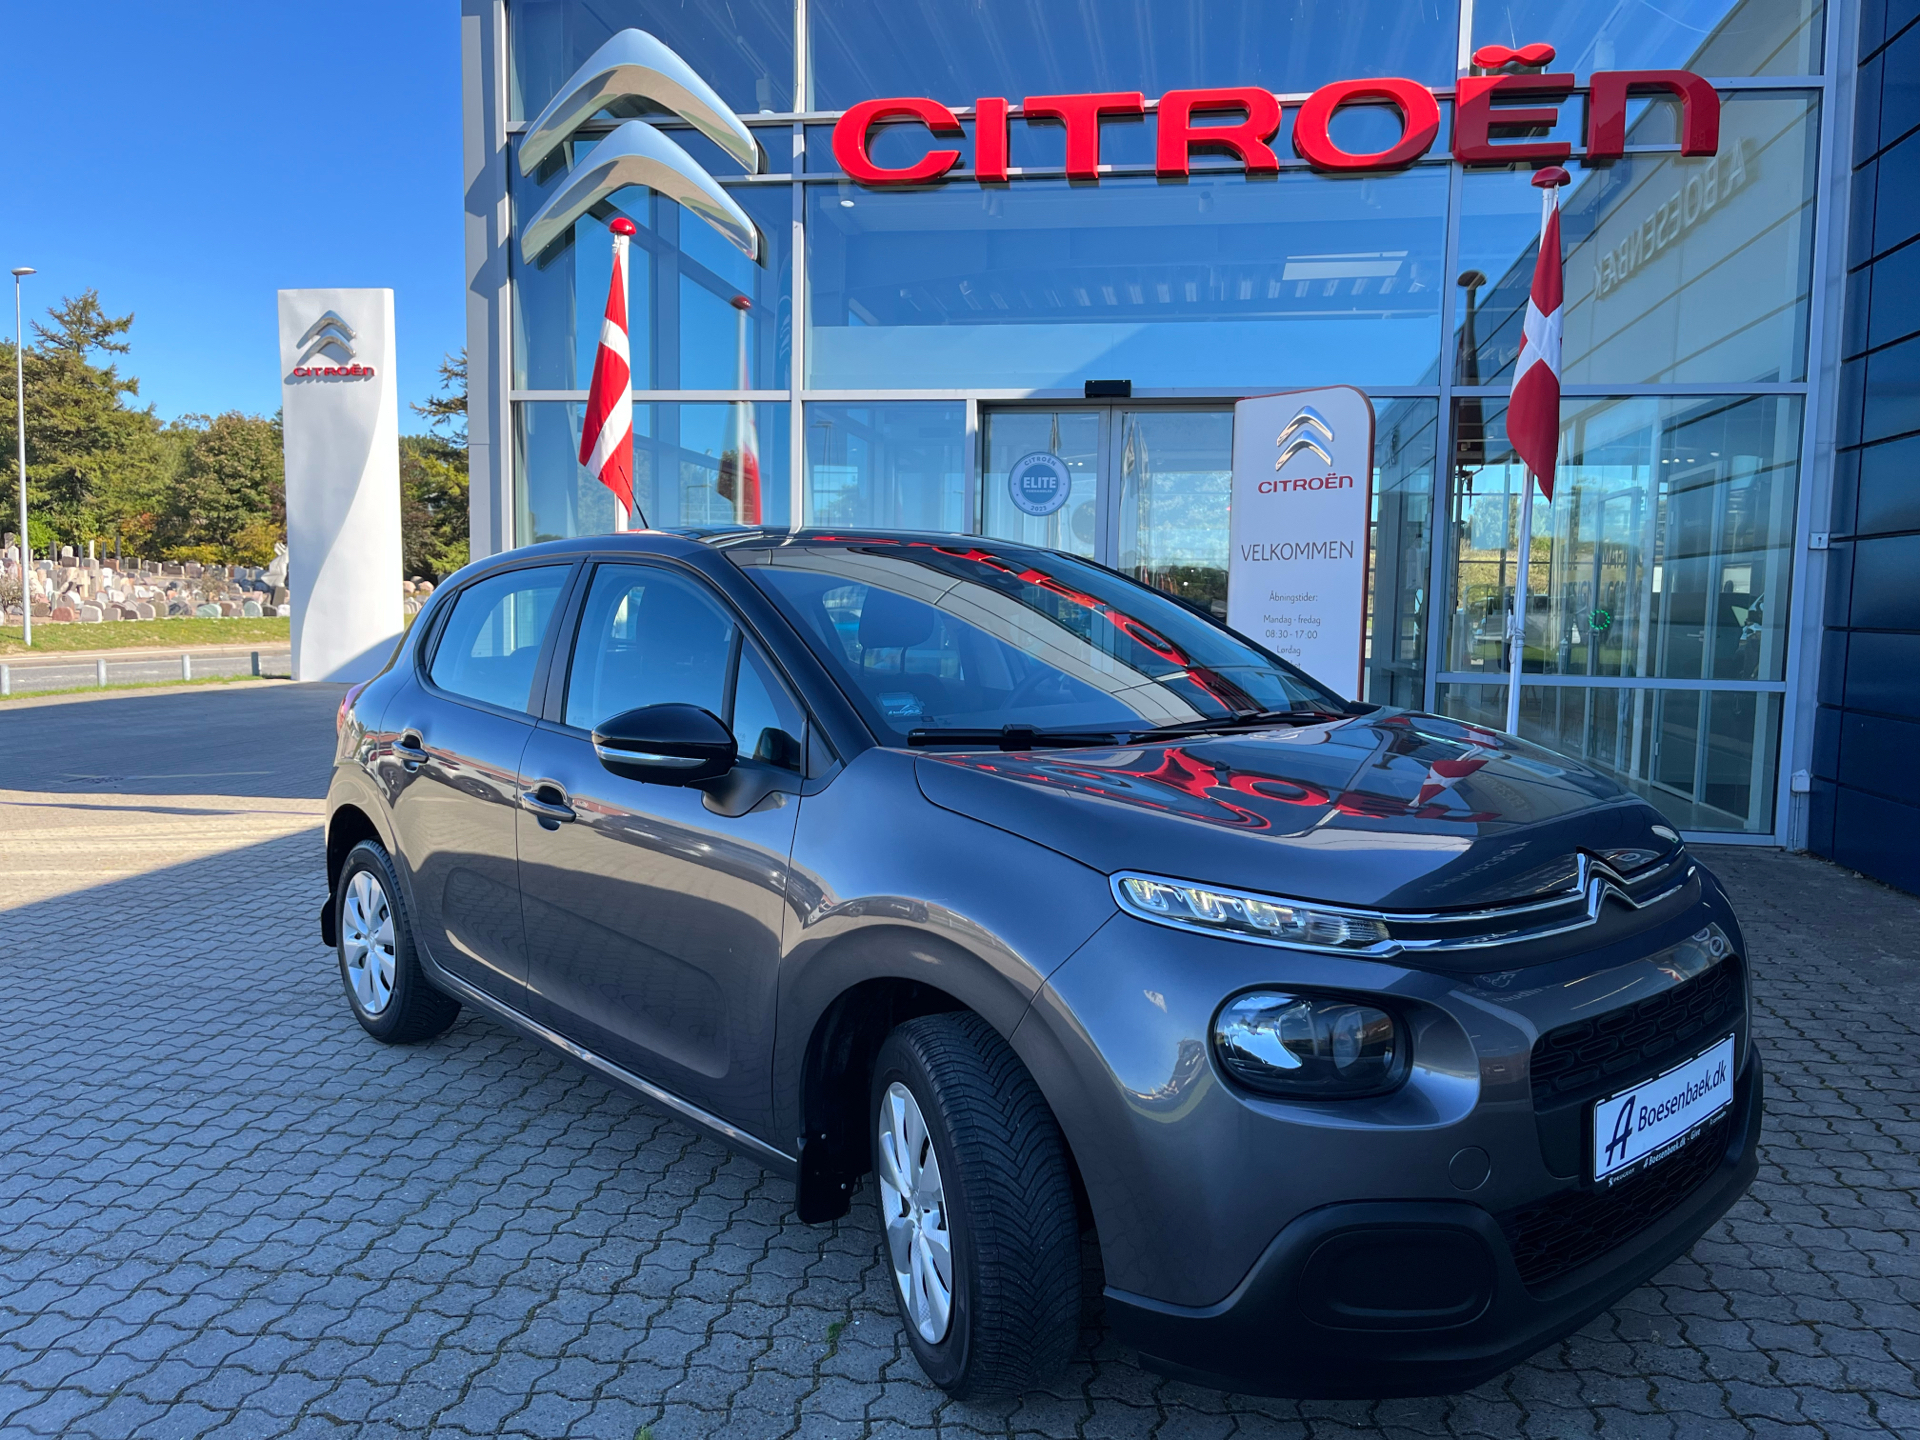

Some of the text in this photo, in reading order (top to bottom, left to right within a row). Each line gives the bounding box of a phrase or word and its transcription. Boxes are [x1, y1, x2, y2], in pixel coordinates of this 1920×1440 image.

[1023, 476, 1057, 489] ELITE
[1258, 473, 1353, 494] CITROËN
[1241, 540, 1354, 562] VELKOMMEN
[1269, 590, 1318, 604] Åbningstider:
[1263, 614, 1292, 626] Mandag
[1298, 614, 1321, 627] fredag
[1265, 629, 1289, 639] 08:30
[1295, 630, 1318, 640] 17:00
[1637, 1060, 1727, 1132] Boesenbaek.dk
